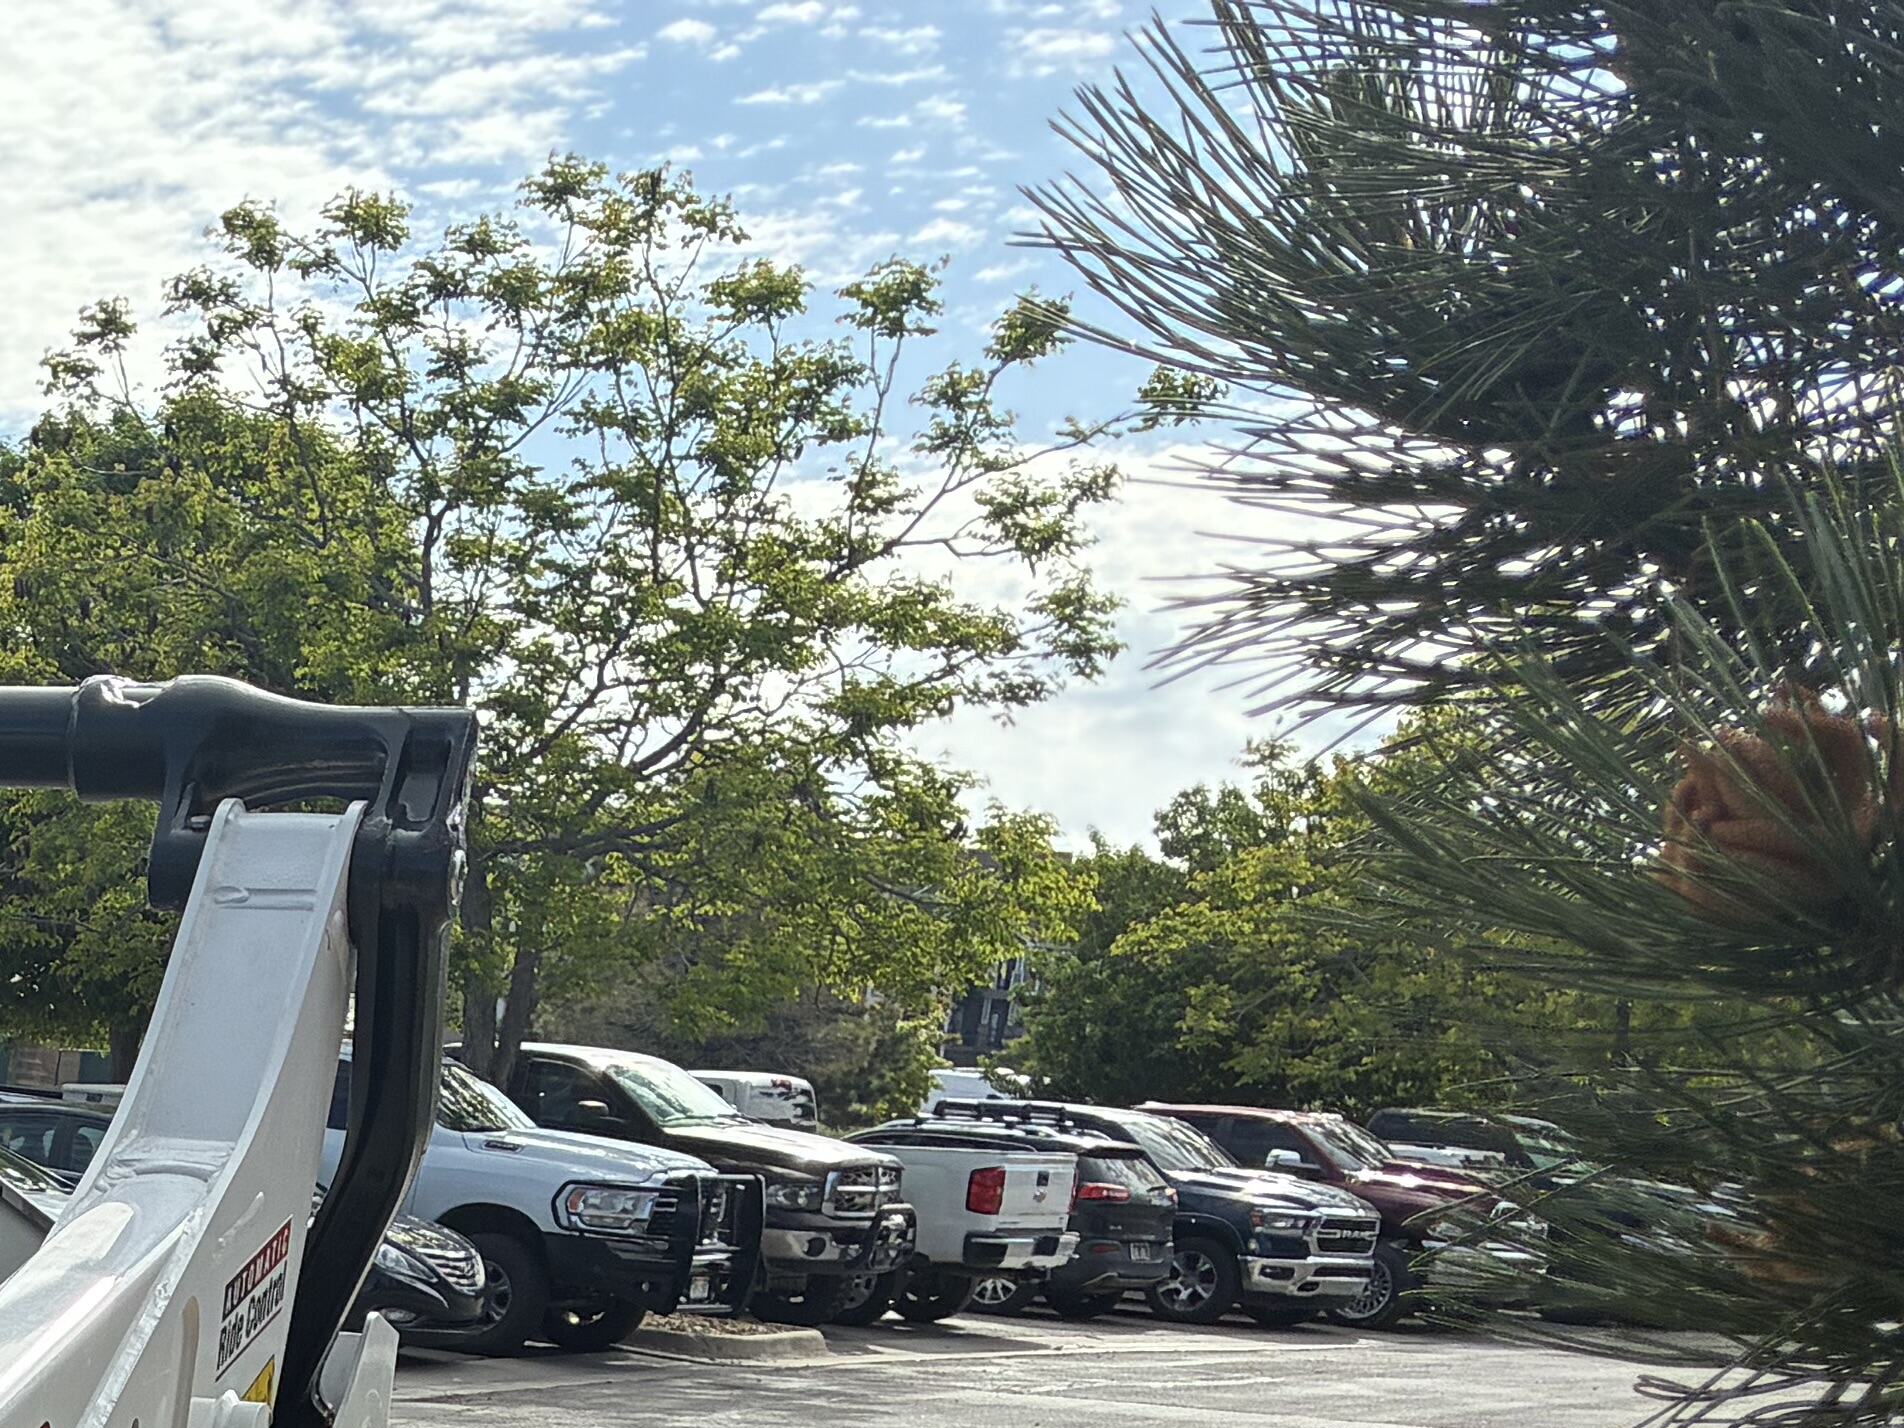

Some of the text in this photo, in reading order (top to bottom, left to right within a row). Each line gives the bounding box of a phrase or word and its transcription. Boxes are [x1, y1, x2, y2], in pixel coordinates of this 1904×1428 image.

[217, 1260, 288, 1371] Ride Control
[224, 1228, 290, 1315] AUTOMATIC
